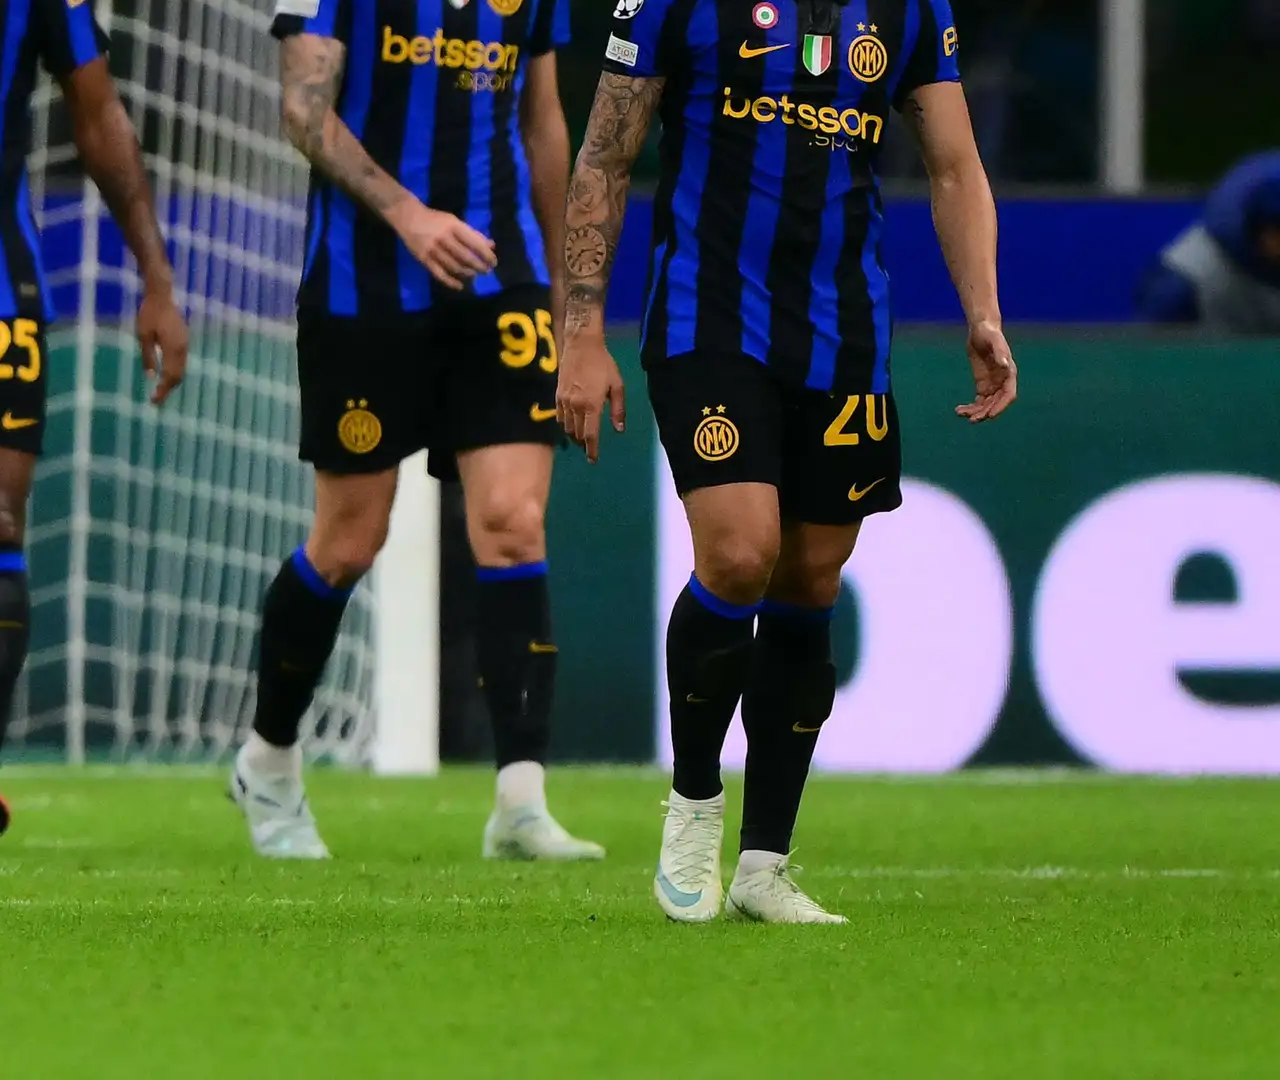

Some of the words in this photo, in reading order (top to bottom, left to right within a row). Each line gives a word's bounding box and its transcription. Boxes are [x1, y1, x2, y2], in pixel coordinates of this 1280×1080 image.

[381, 26, 519, 72] betsson
[722, 86, 884, 144] betsson
[497, 309, 558, 373] 95
